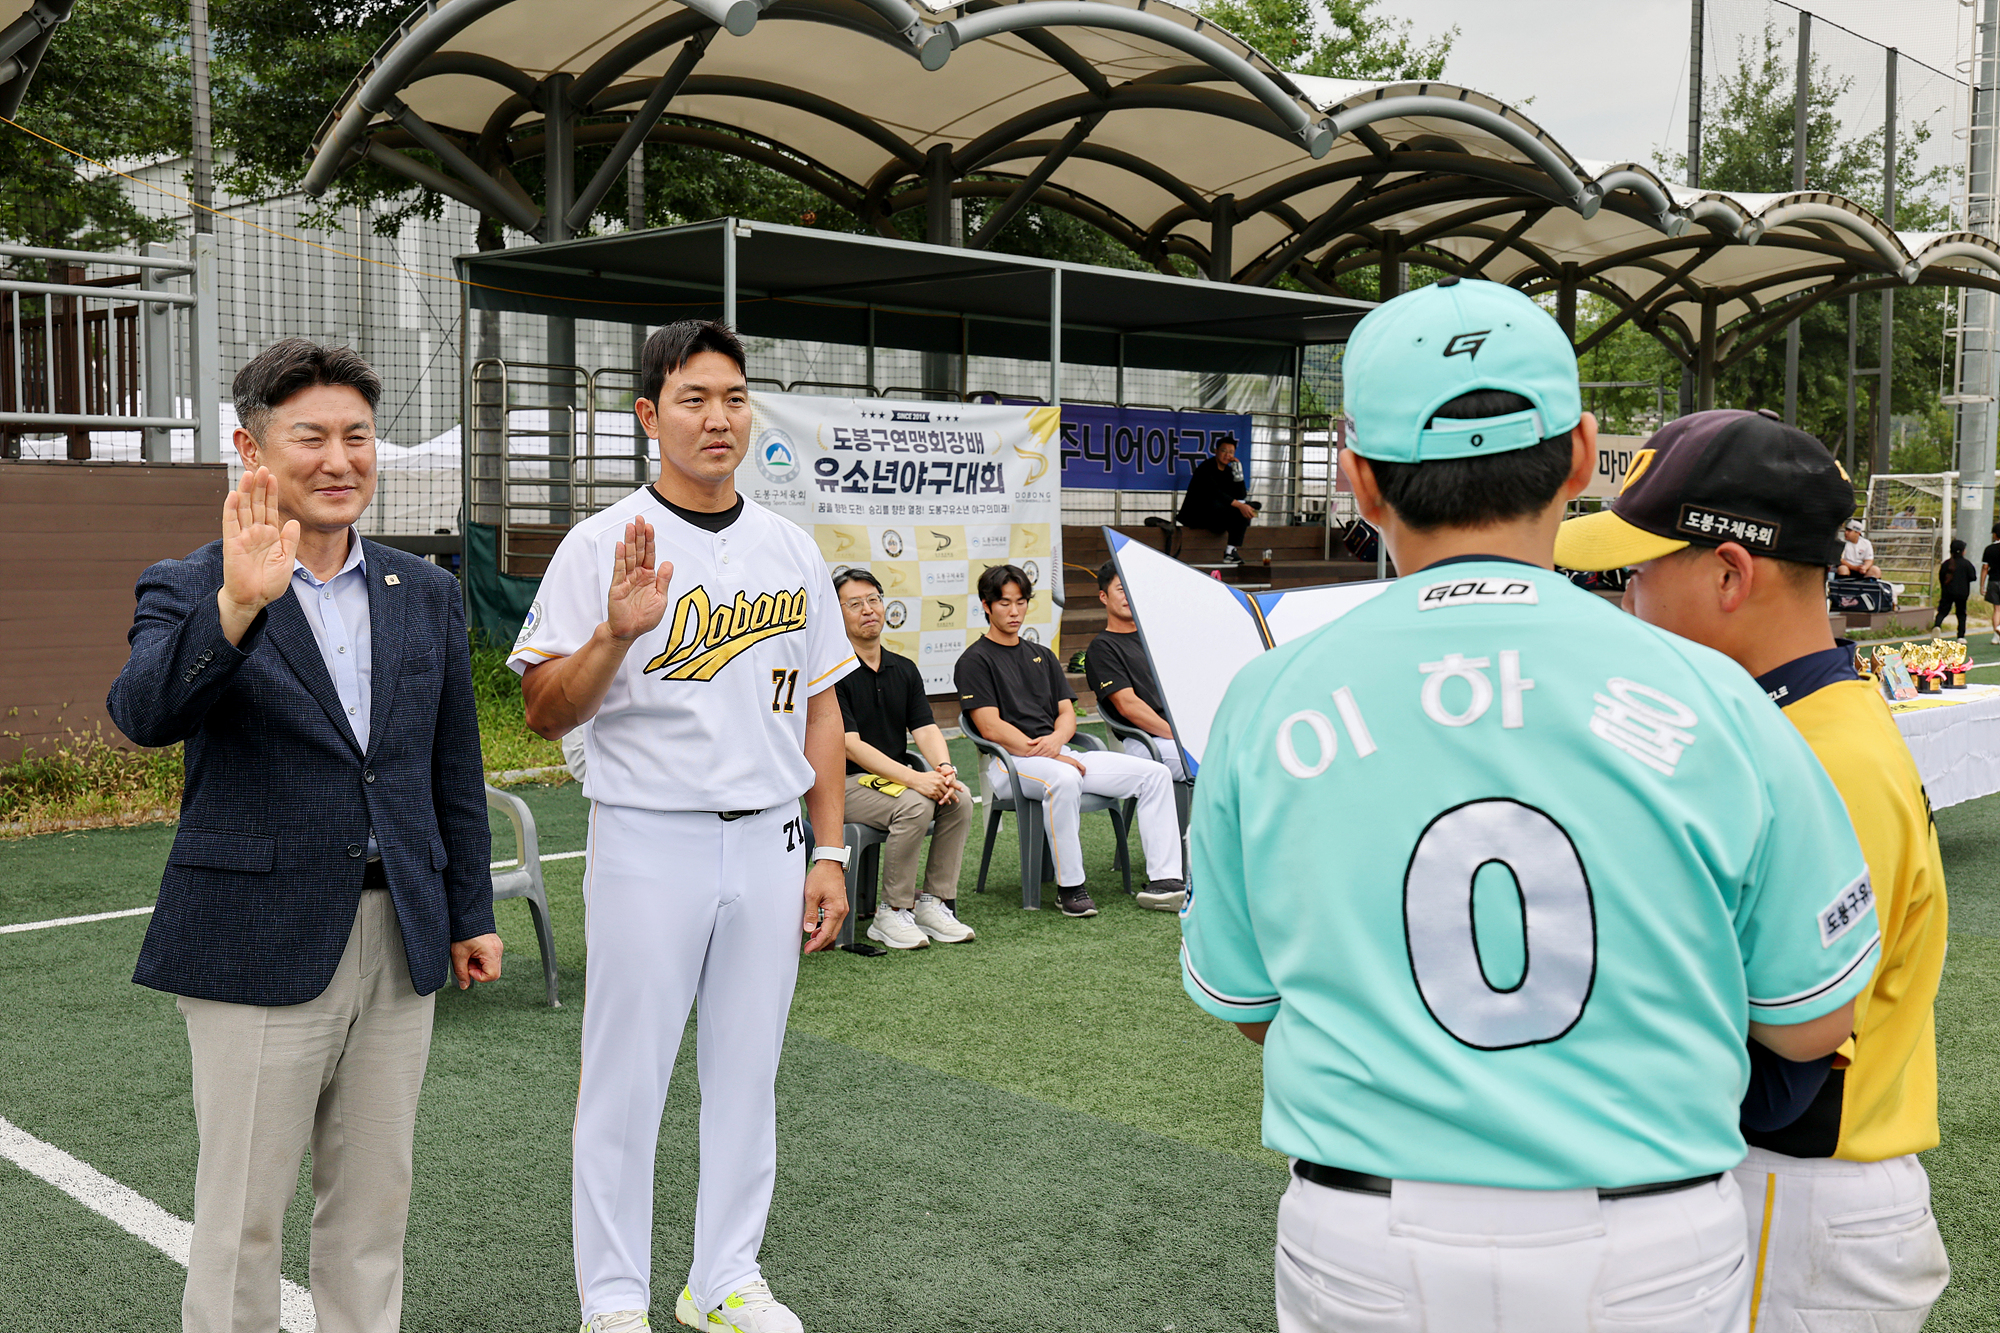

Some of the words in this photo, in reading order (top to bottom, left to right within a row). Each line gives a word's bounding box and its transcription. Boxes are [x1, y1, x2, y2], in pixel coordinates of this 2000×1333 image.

[896, 411, 912, 420] SINCE
[912, 413, 926, 421] 2014
[833, 426, 985, 455] 도봉구연맹회장배
[814, 457, 1005, 495] 유소년야구대회
[753, 489, 806, 501] 도봉구체육회
[818, 502, 833, 513] 꿈을
[834, 503, 847, 514] 향한
[848, 504, 865, 515] 도전!
[868, 504, 889, 515] 승리를
[891, 504, 906, 515] 향한
[908, 504, 925, 515] 열정!
[928, 504, 970, 515] 도봉구유소년
[1015, 491, 1051, 499] DOBONG
[1685, 511, 1774, 547] 도봉구체육회
[1423, 581, 1531, 604] GOLD
[643, 585, 807, 682] Dobong
[771, 668, 799, 714] 71
[783, 815, 805, 853] 71
[1402, 797, 1597, 1052] 0
